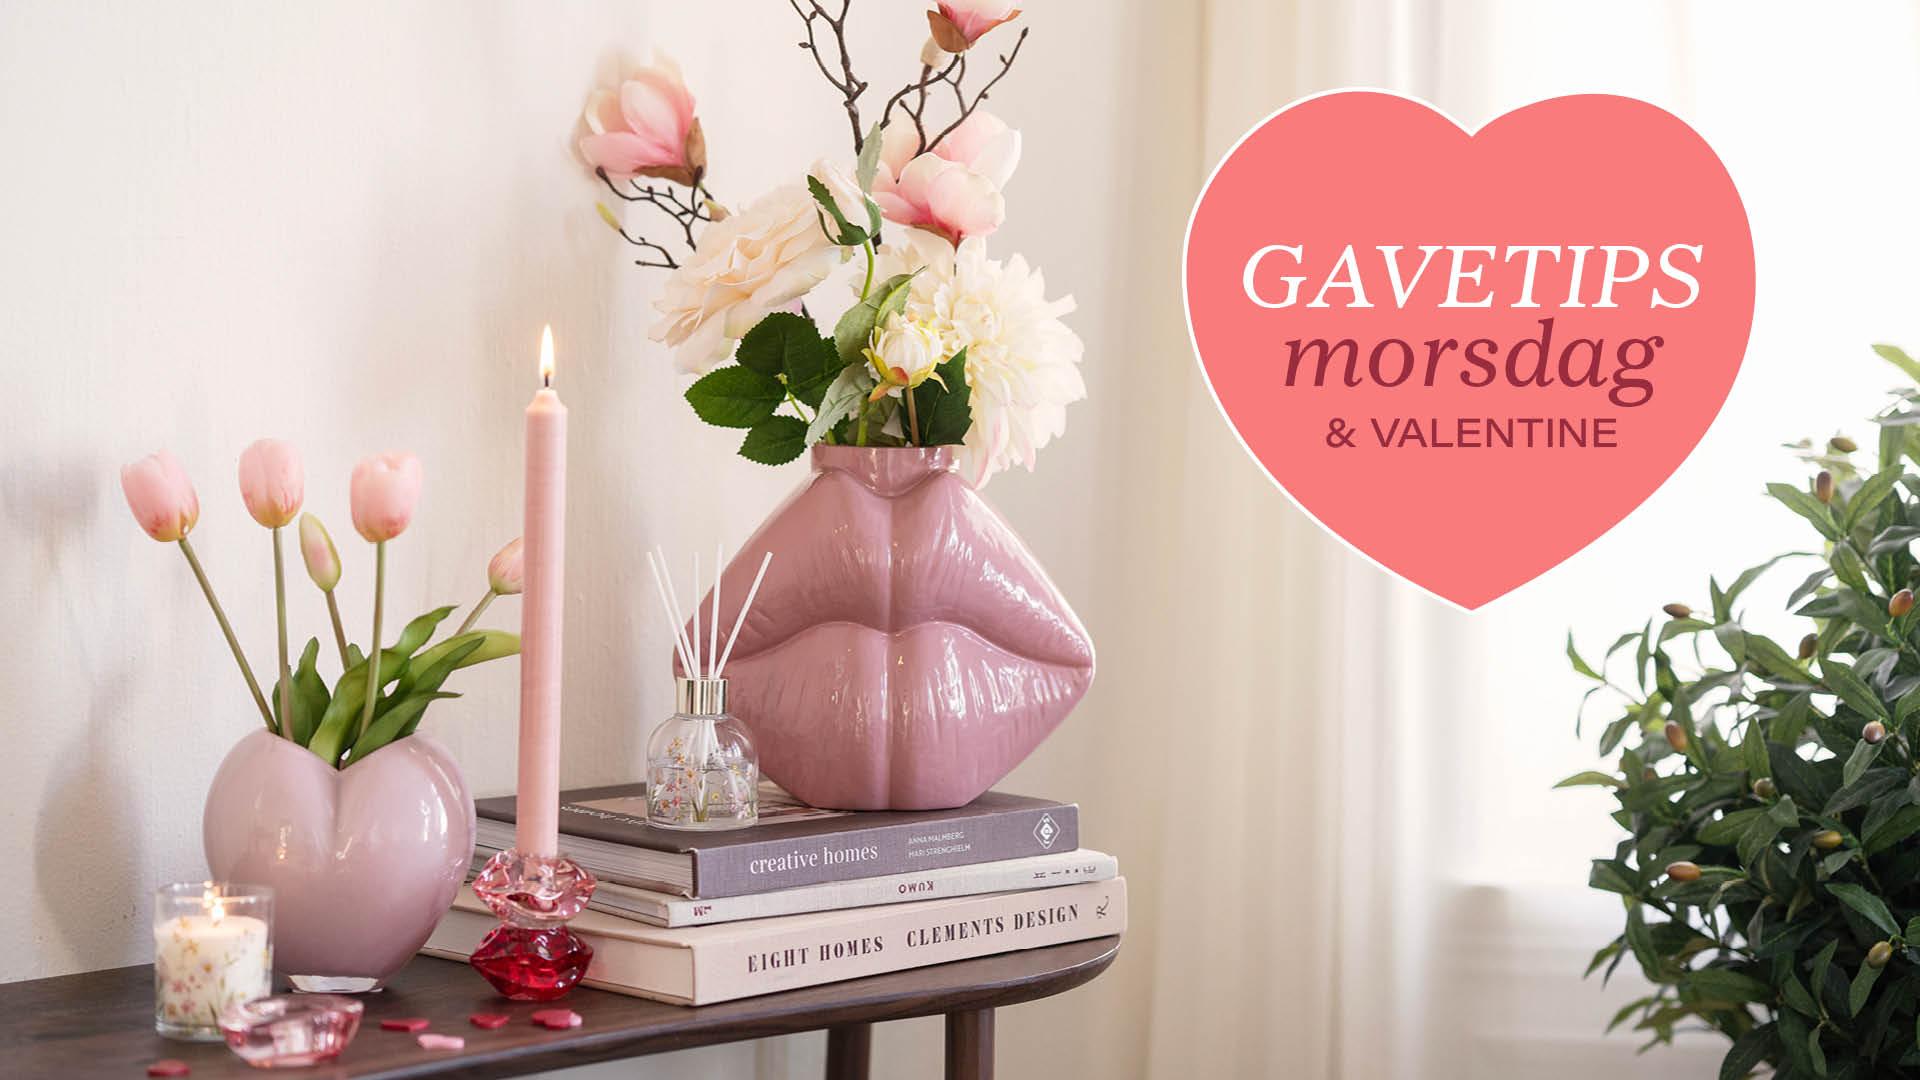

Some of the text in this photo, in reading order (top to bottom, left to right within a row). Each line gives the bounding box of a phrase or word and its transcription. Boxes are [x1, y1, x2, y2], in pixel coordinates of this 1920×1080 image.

[750, 845, 879, 875] creative homes
[906, 903, 1079, 948] CLEMENTS DESIGN
[748, 936, 884, 974] EIGHT HOMES
